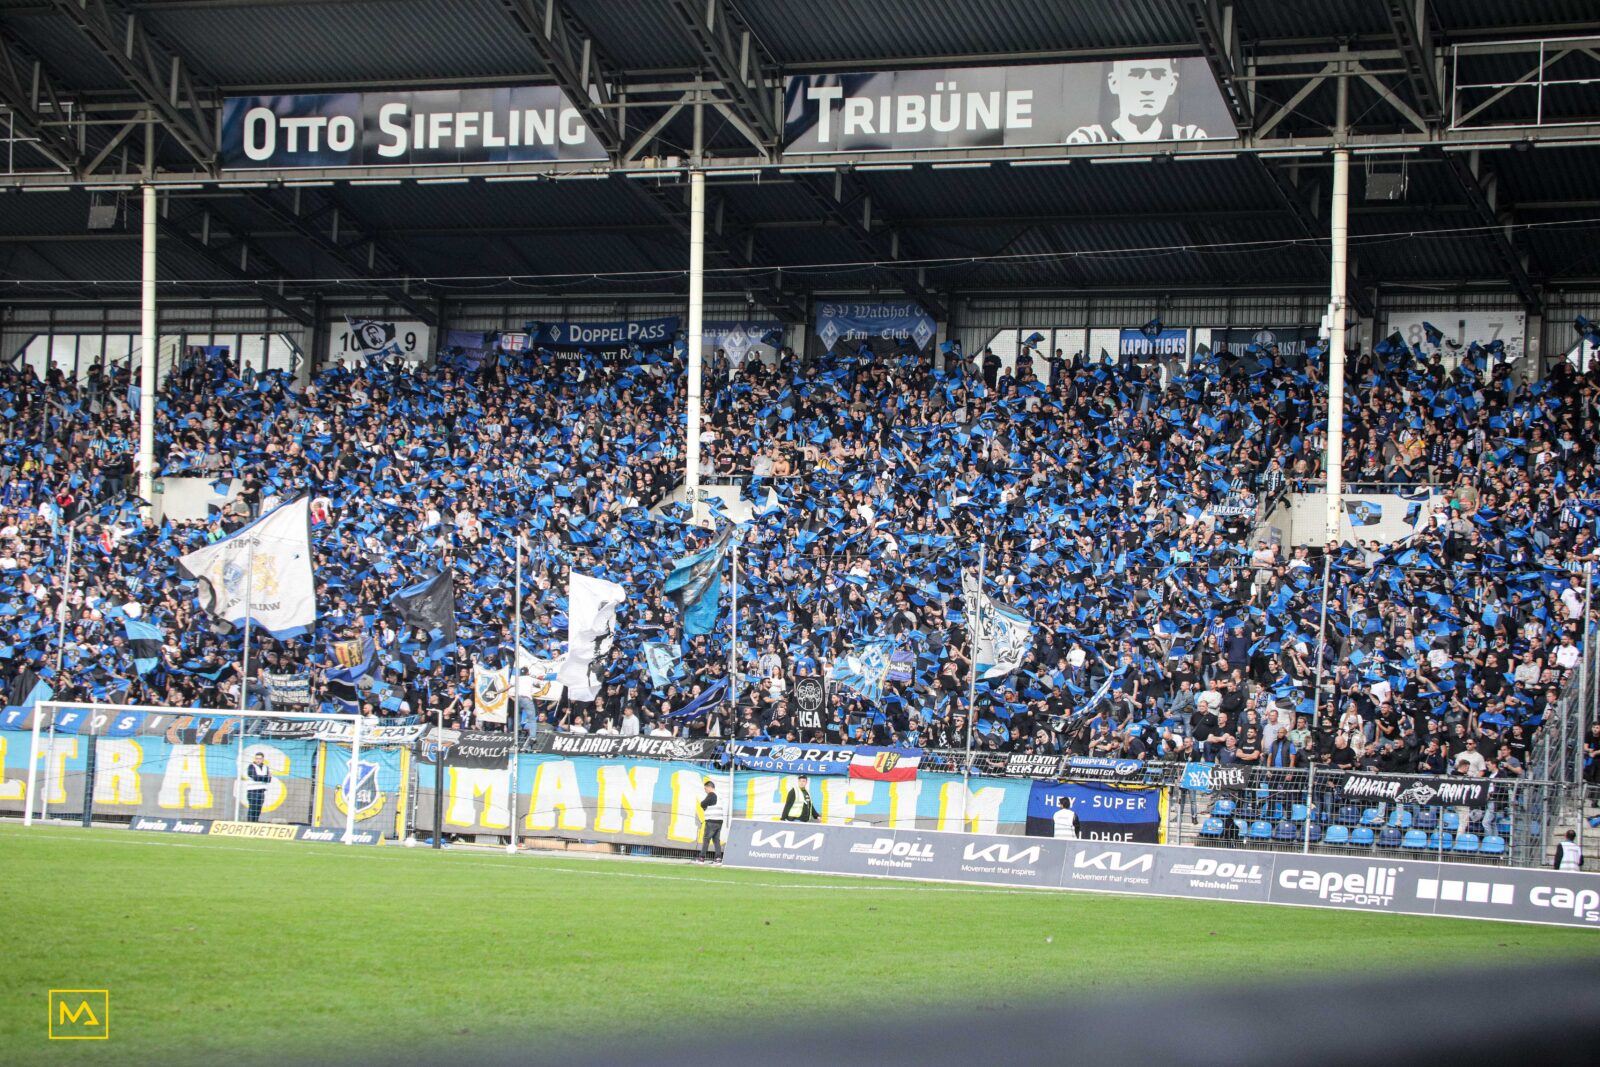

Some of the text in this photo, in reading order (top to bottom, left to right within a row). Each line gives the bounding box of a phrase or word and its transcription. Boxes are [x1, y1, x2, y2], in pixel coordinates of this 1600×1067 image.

[806, 82, 1034, 143] TRIBÜNE
[798, 710, 822, 729] KSA
[1093, 795, 1147, 810] SUPER
[136, 819, 168, 831] bwin
[172, 820, 205, 833] bwin
[212, 822, 294, 839] SPORTWETTEN
[302, 828, 335, 841] bwin
[961, 864, 996, 873] Movement
[1011, 868, 1036, 877] inspires
[1072, 872, 1108, 881] Movement
[1123, 876, 1150, 885] inspires
[1189, 879, 1239, 890] Weinheim
[1279, 867, 1397, 898] capelli
[1329, 893, 1394, 906] SPORT
